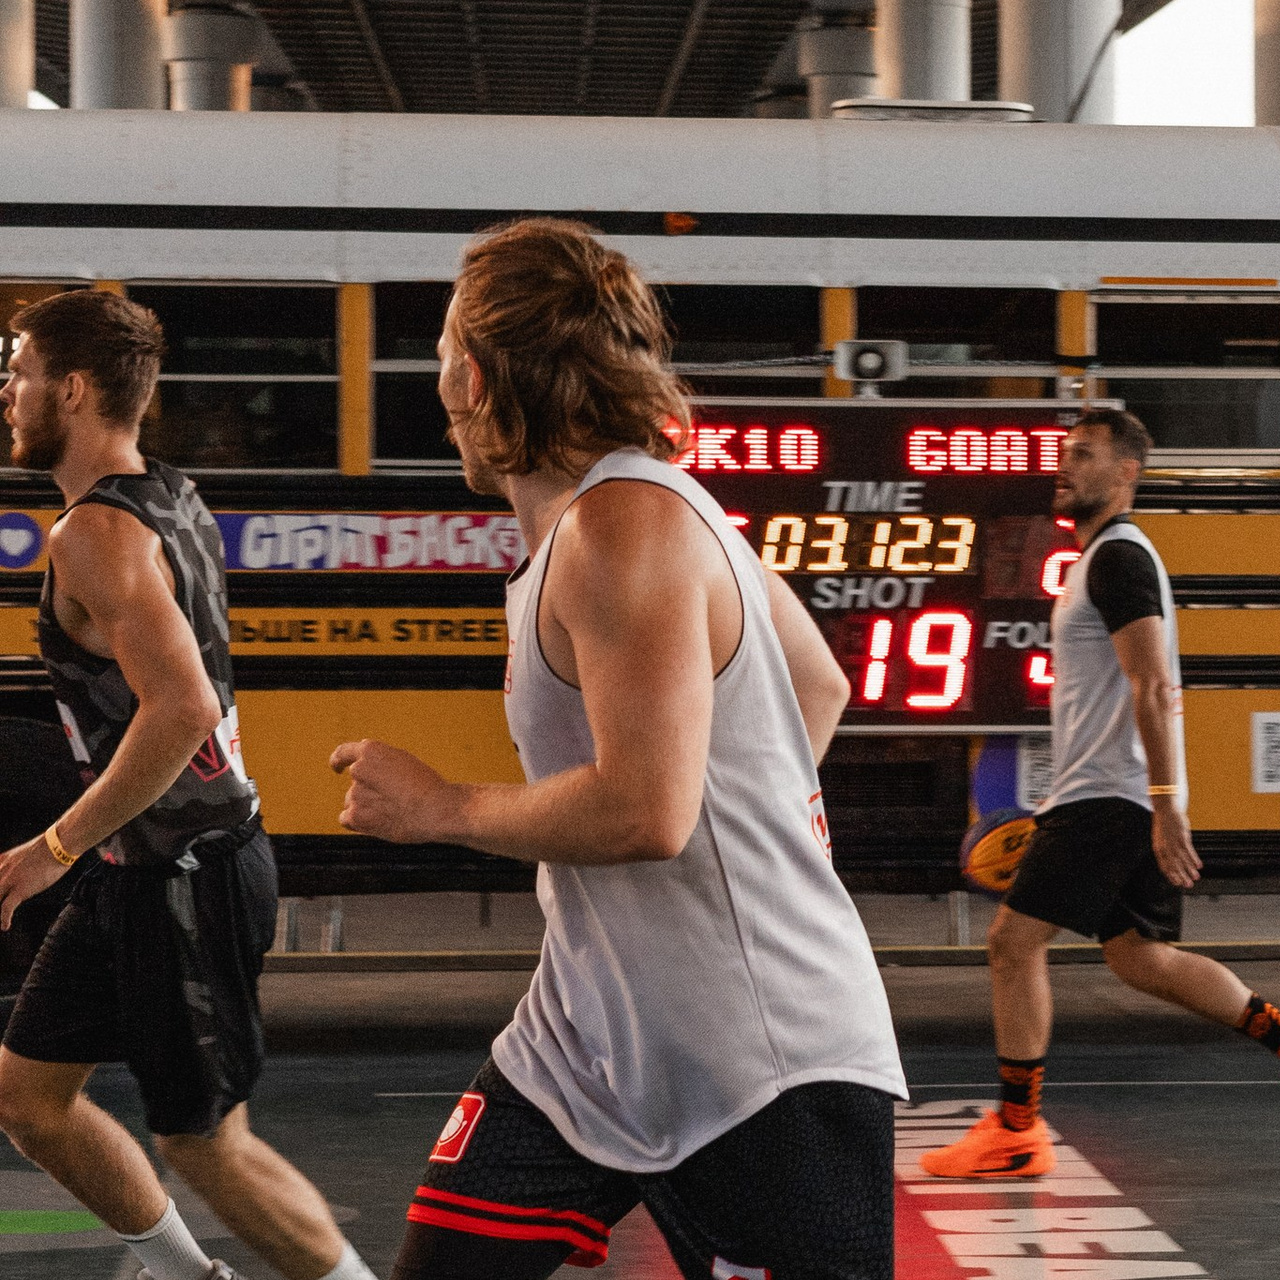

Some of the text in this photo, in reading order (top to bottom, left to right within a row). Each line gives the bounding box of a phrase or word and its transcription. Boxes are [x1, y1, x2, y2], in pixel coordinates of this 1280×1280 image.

[822, 481, 926, 512] TIME
[811, 577, 936, 609] SHOT
[329, 620, 379, 642] НА
[393, 619, 508, 643] STREE
[983, 621, 1053, 649] FOU
[863, 612, 972, 708] 19
